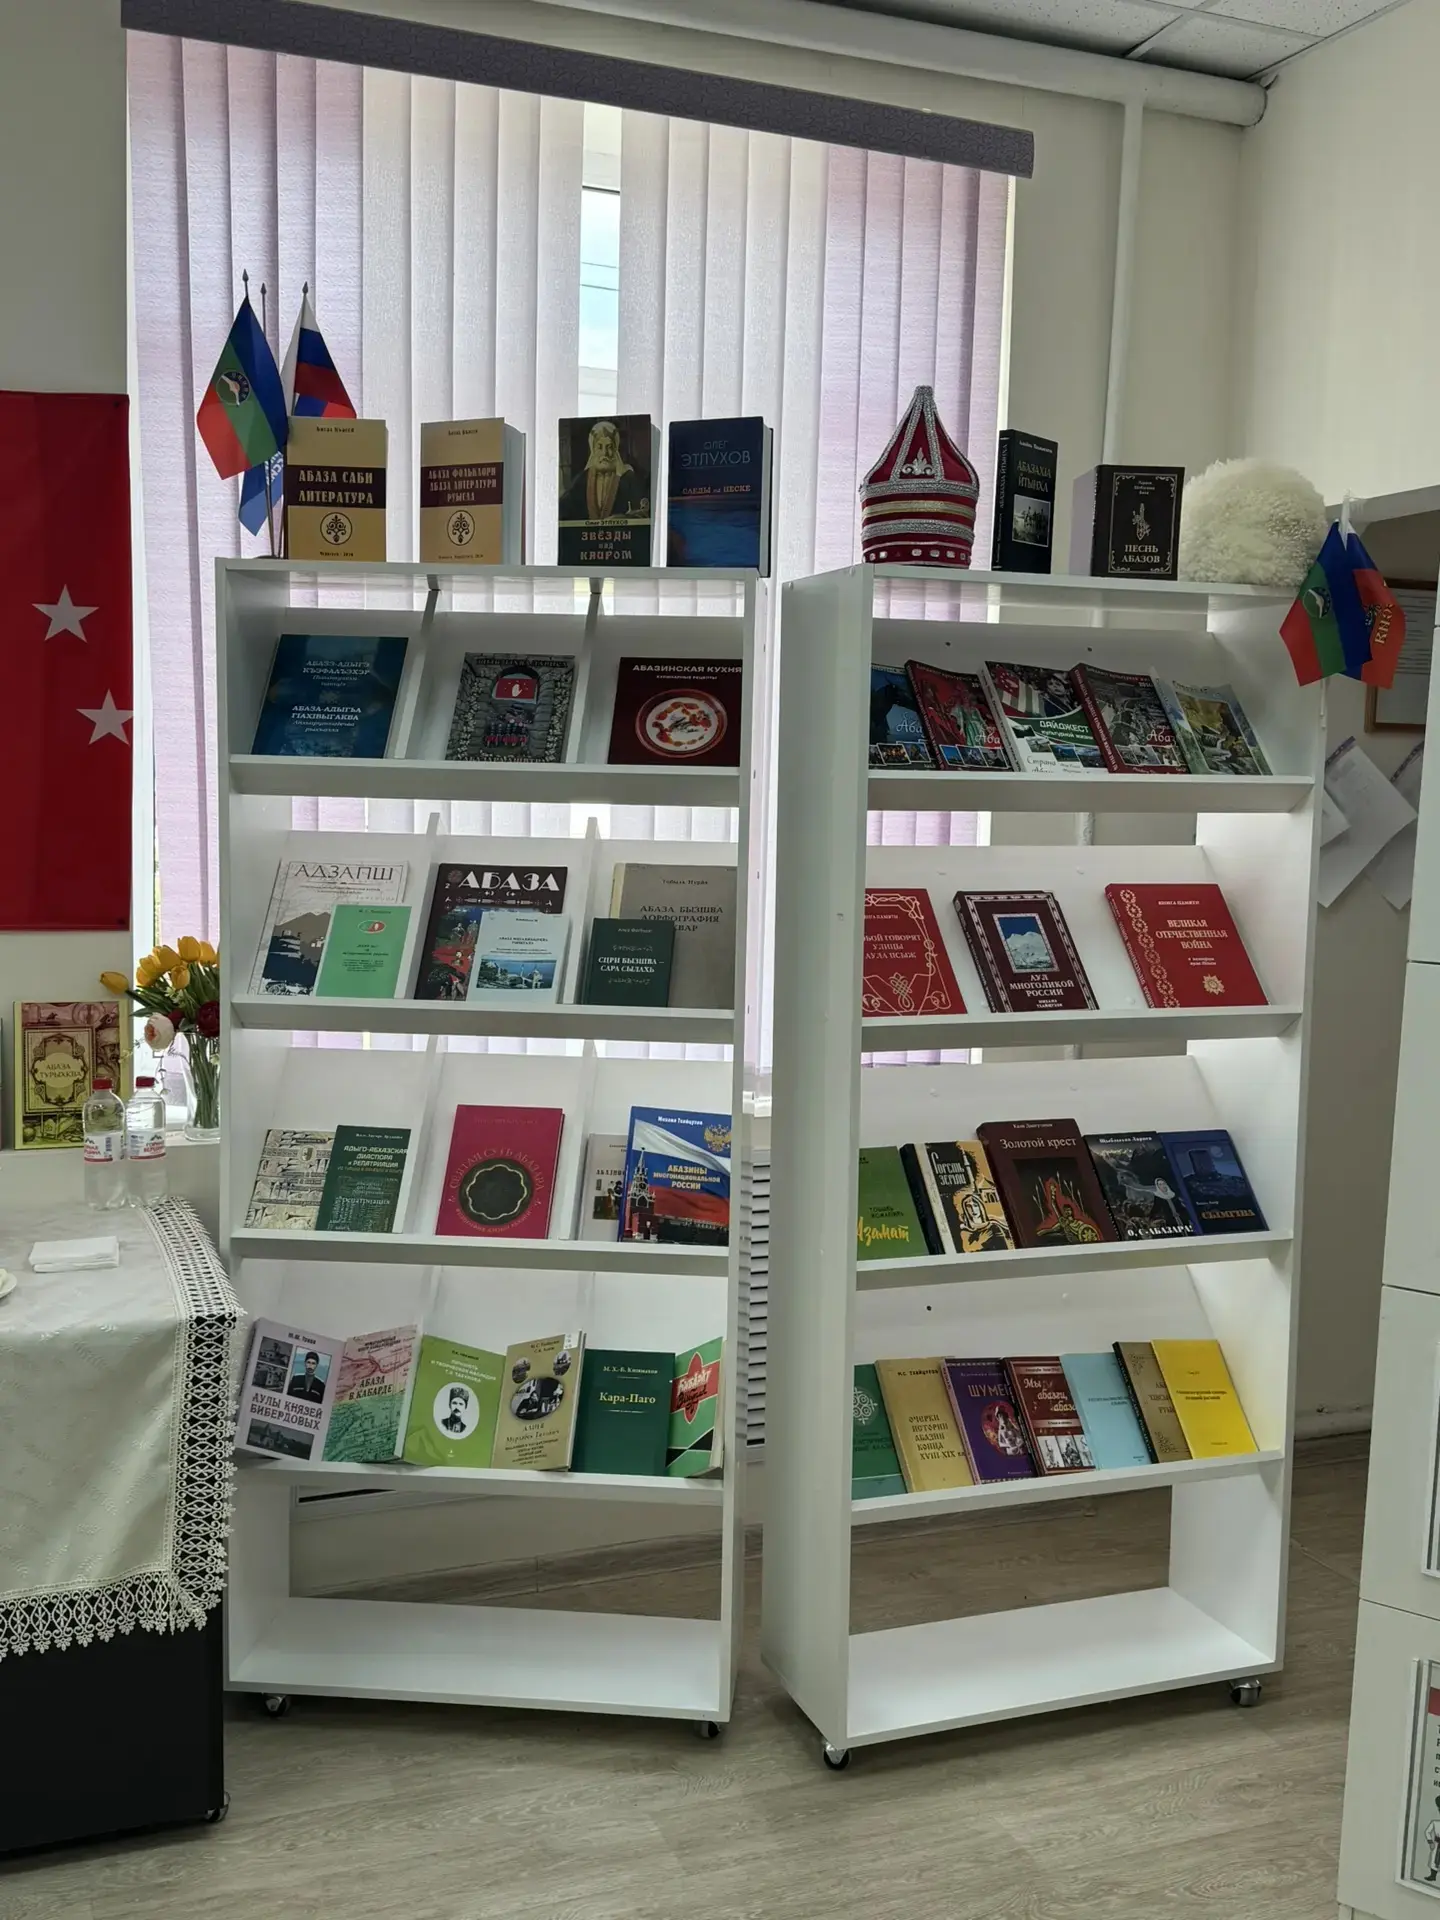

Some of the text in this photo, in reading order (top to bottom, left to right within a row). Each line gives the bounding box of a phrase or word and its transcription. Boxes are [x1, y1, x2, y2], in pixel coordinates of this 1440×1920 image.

[704, 441, 729, 450] ОЛЕГ
[681, 451, 750, 467] ЭТЛУХОВ
[299, 469, 374, 485] АБАЗА САБИ
[429, 470, 450, 480] АБАЗА
[430, 481, 451, 492] АБАЗА
[682, 487, 712, 495] СЛЕДЫ
[723, 485, 752, 493] ПЕСКЕ
[298, 489, 374, 505] ЛИТЕРАТУРА
[1124, 544, 1159, 554] ПЕСНЬ
[1121, 554, 1161, 564] АБАЗОВ
[632, 664, 705, 673] АБАЗИНСКАЯ
[1039, 719, 1089, 734] ДАЙДЖЕСТ
[294, 864, 394, 881] АДЗАПШ
[458, 871, 560, 892] АБАЗА
[640, 905, 724, 914] АБАЗА БЫЗШВА
[1166, 918, 1209, 928] ВЕЛИКАЯ
[884, 934, 922, 942] ГОВОРЯТ
[1155, 929, 1229, 939] ОТЕЧЕСТВЕННАЯ
[872, 943, 904, 951] УЛИЦЫ
[1180, 939, 1213, 950] ВОЙНА
[865, 952, 888, 960] АУЛА
[1030, 973, 1049, 982] АУЛ
[1009, 979, 1075, 990] МНОГОЛИКОЙ
[1026, 988, 1064, 997] РОССИИ
[1000, 1137, 1077, 1150] Золотой крест
[355, 1153, 393, 1161] ДИАСПОРА
[667, 1164, 708, 1175] АБАЗИНЫ
[671, 1180, 701, 1190] РОССИИ
[359, 1375, 386, 1388] АБАЗА
[349, 1384, 393, 1401] В КАБАРДЕ
[599, 1391, 656, 1405] Кара-Паго
[252, 1392, 324, 1420] АУЛЫ КНЯЗЕЙ
[250, 1403, 321, 1431] БИБЕРДОВЫХ
[908, 1414, 940, 1423] ОЧЕРКИ
[912, 1423, 949, 1433] ИСТОРИИ
[915, 1433, 945, 1442] АБАЗИН
[917, 1442, 944, 1452] КОНЦА
